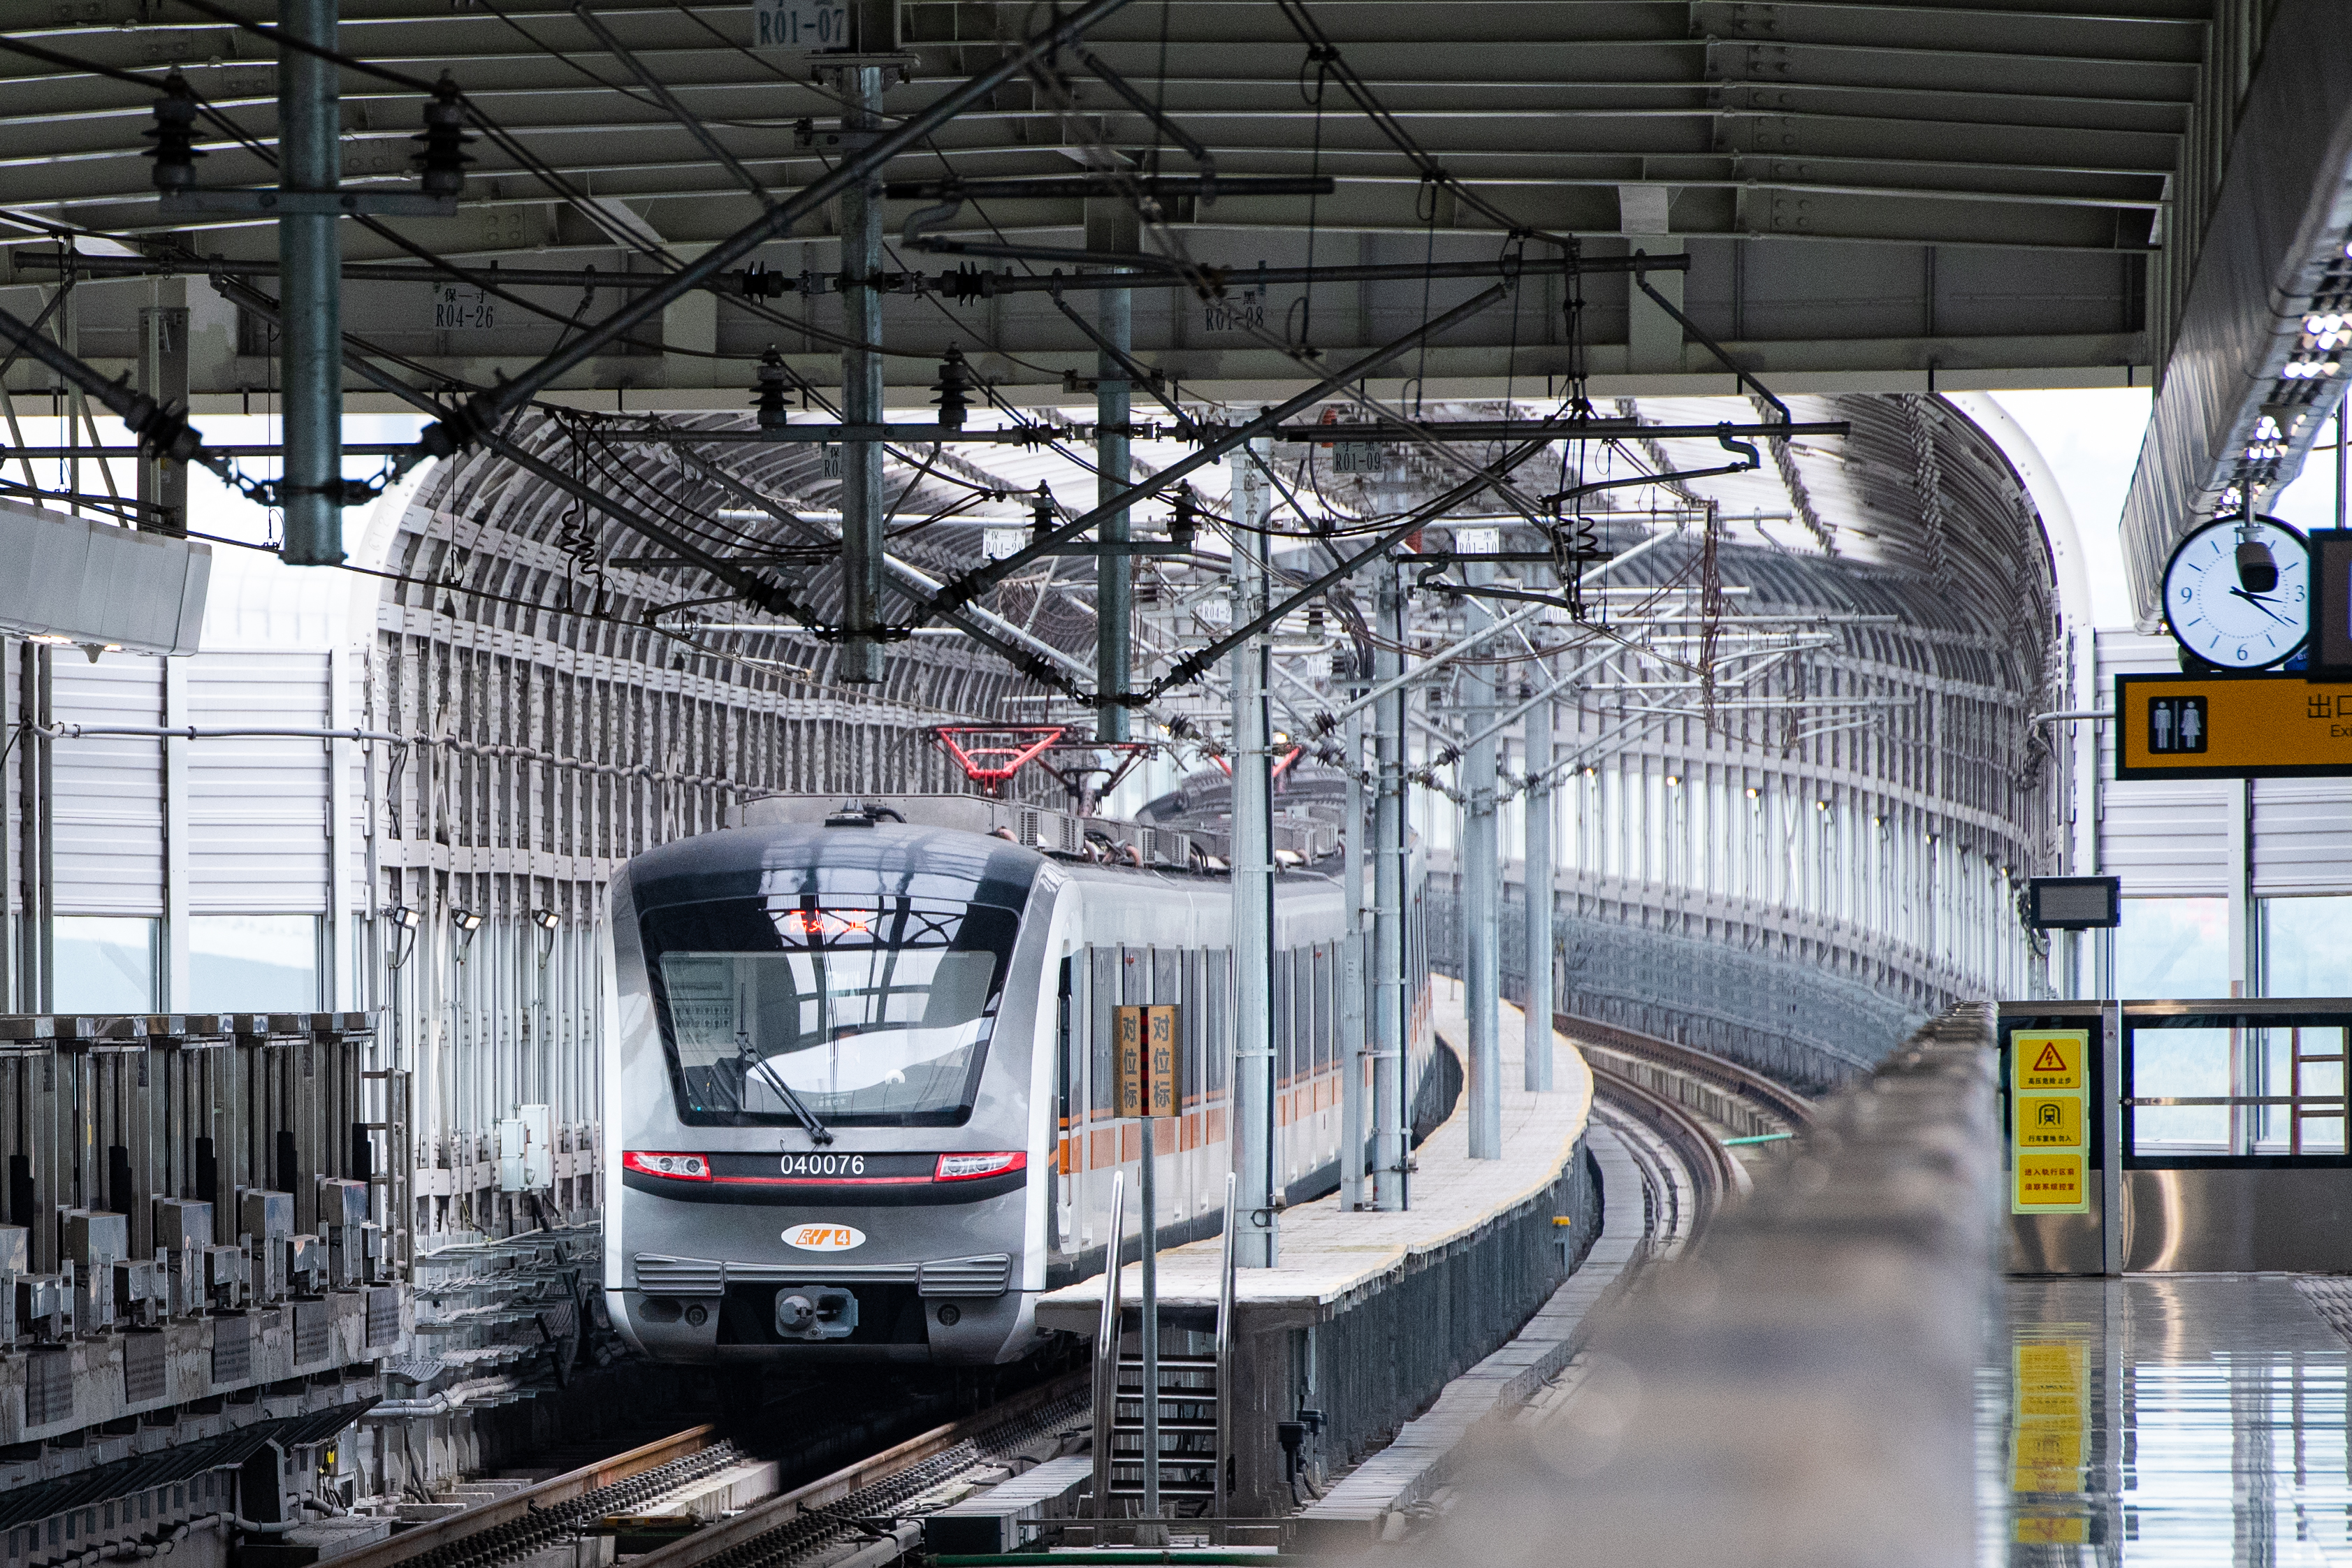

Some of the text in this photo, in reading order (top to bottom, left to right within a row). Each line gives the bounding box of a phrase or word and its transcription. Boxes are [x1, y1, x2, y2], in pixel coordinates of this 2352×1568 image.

[760, 8, 845, 43] R01-07
[436, 304, 493, 328] R04-26
[1206, 306, 1263, 331] R01-08
[1336, 452, 1381, 470] R01-09
[1459, 542, 1497, 553] R01-10
[2181, 587, 2193, 604] 9
[2295, 585, 2305, 602] 3
[2237, 643, 2248, 660] 6
[2308, 694, 2352, 718] 出口
[1123, 1015, 1138, 1108] 对位标
[1154, 1015, 1170, 1108] 对位标
[781, 1154, 864, 1175] 040076
[836, 1230, 849, 1244] 4
